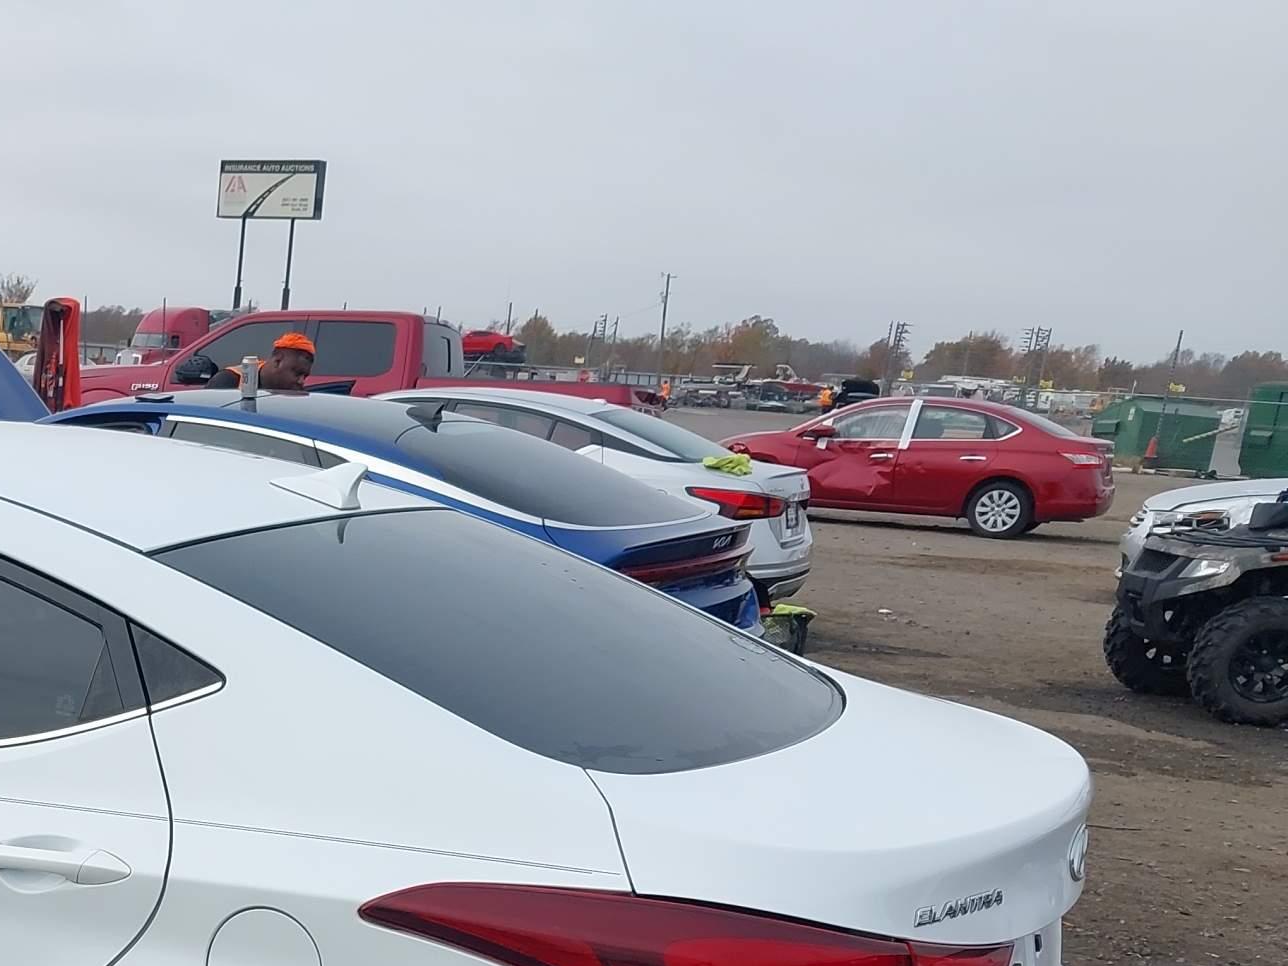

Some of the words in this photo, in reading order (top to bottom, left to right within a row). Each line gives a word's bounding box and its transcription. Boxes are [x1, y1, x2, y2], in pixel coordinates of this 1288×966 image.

[224, 164, 261, 172] INSURANCE
[262, 164, 280, 172] AUTO
[281, 164, 315, 173] AUCTIONS
[914, 888, 1003, 927] ELANTRA
